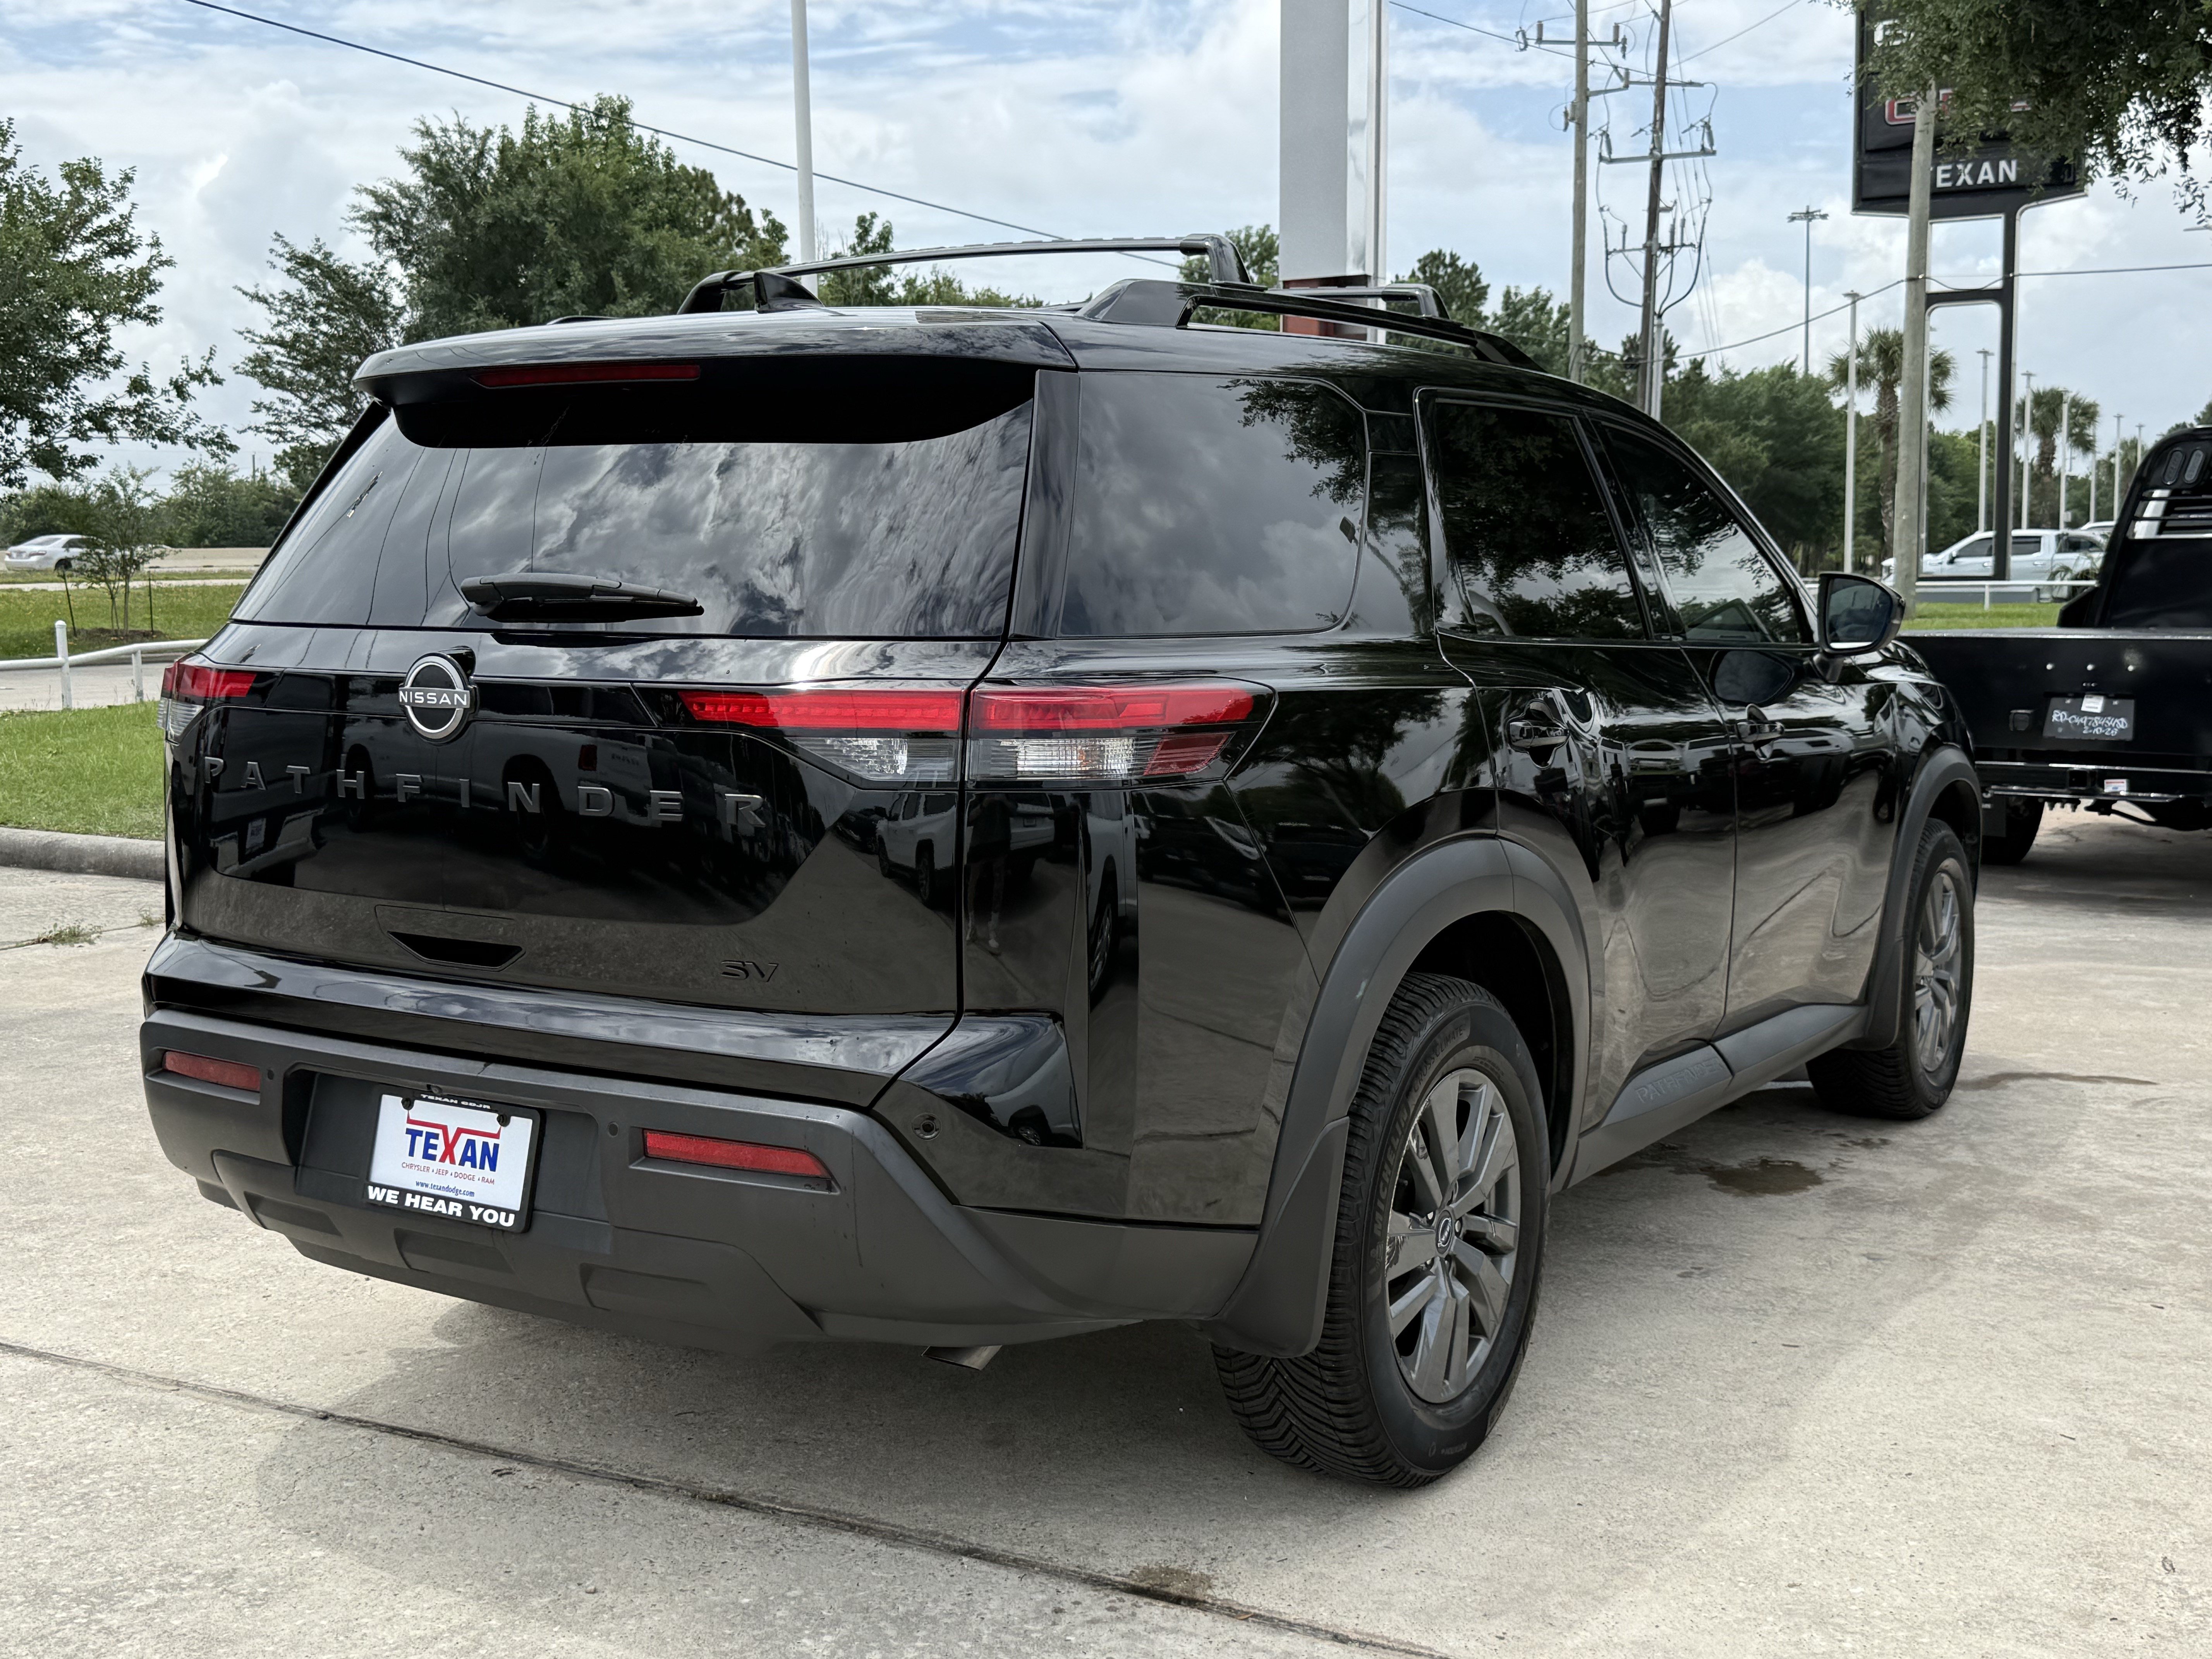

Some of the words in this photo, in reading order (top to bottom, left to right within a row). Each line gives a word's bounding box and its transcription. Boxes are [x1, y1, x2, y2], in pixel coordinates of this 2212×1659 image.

[1930, 159, 2017, 189] EXAN
[399, 690, 467, 706] NISSAN
[204, 756, 767, 828] PATHFINDER
[720, 960, 779, 982] SV
[420, 1094, 458, 1104] TEXAN
[405, 1125, 500, 1173] TEXAN
[402, 1162, 431, 1173] CHRYSLER
[435, 1168, 449, 1176] JEEP
[454, 1171, 476, 1182] DODGE
[481, 1176, 495, 1185] RAM
[1374, 1104, 1408, 1237] MICHELIN
[416, 1181, 475, 1197] www.texandodge.com
[368, 1185, 400, 1204] WE
[404, 1193, 463, 1217] HEAR
[469, 1205, 515, 1227] YOU
